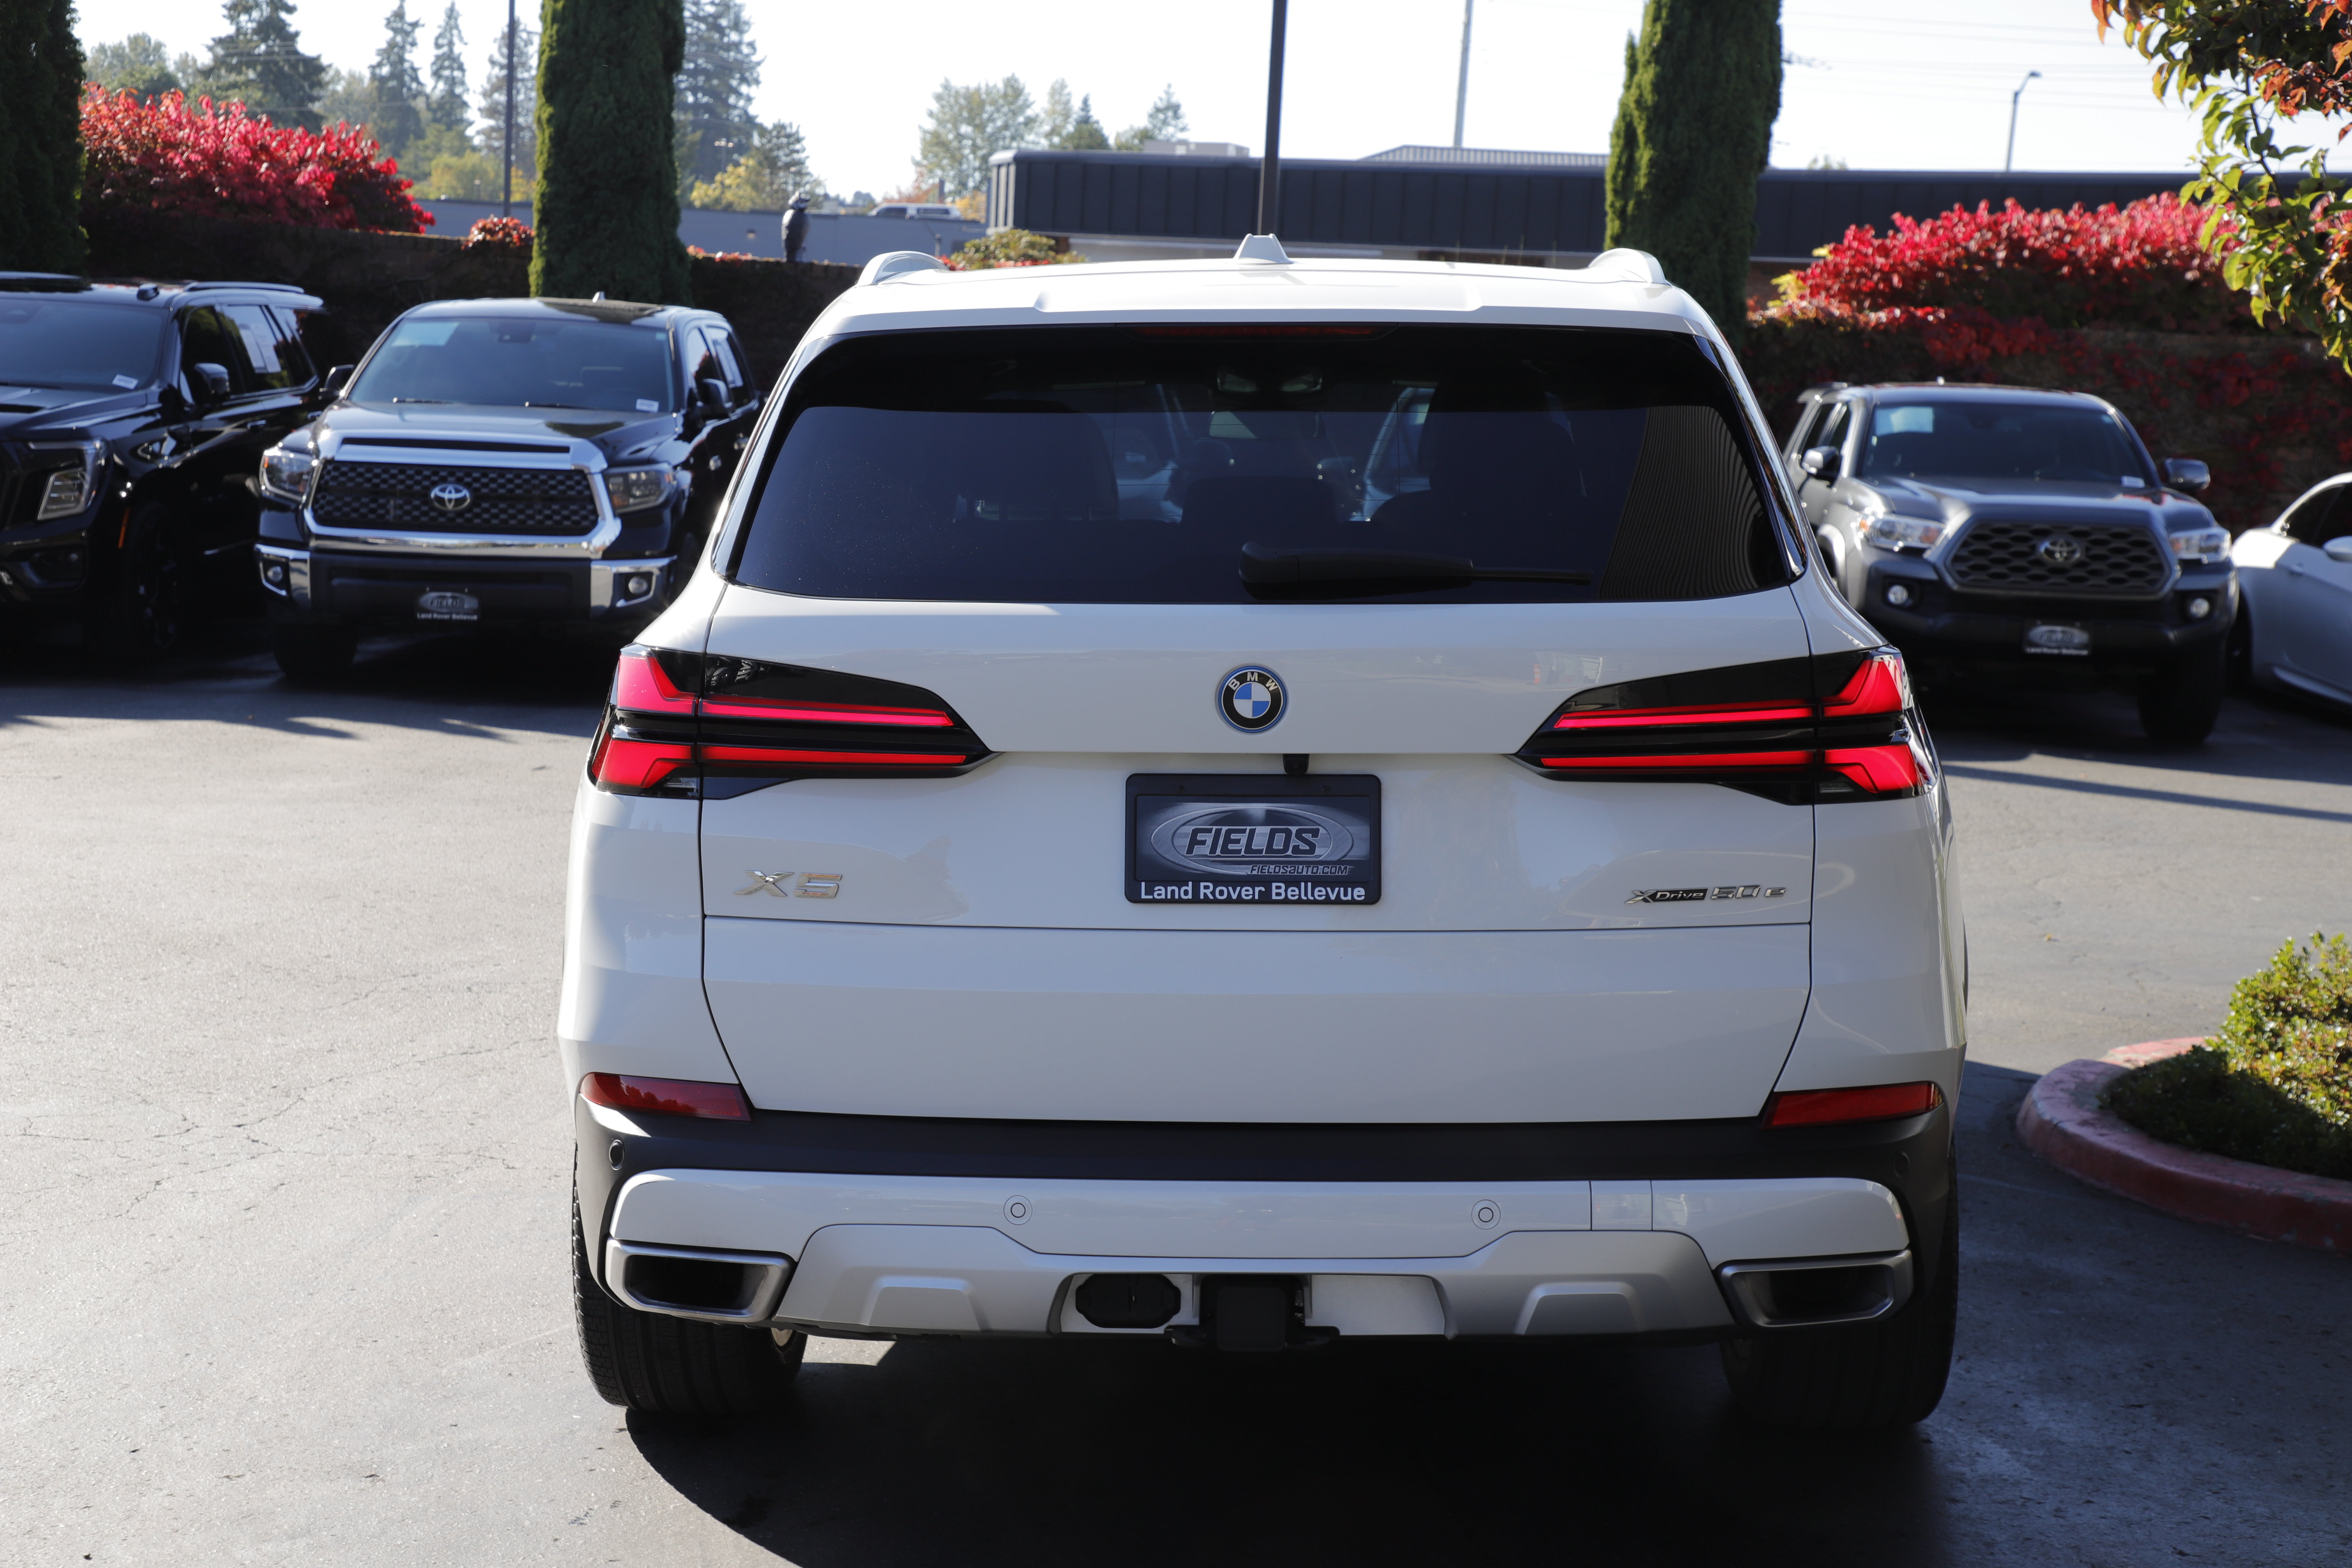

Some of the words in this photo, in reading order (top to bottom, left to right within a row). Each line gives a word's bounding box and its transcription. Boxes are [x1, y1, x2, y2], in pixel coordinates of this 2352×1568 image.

[1228, 671, 1278, 690] BMW
[1185, 826, 1321, 856] FIELDS
[733, 869, 843, 899] X5
[1140, 881, 1193, 900] Land
[1199, 882, 1265, 900] Rover
[1272, 882, 1366, 901] Bellevue
